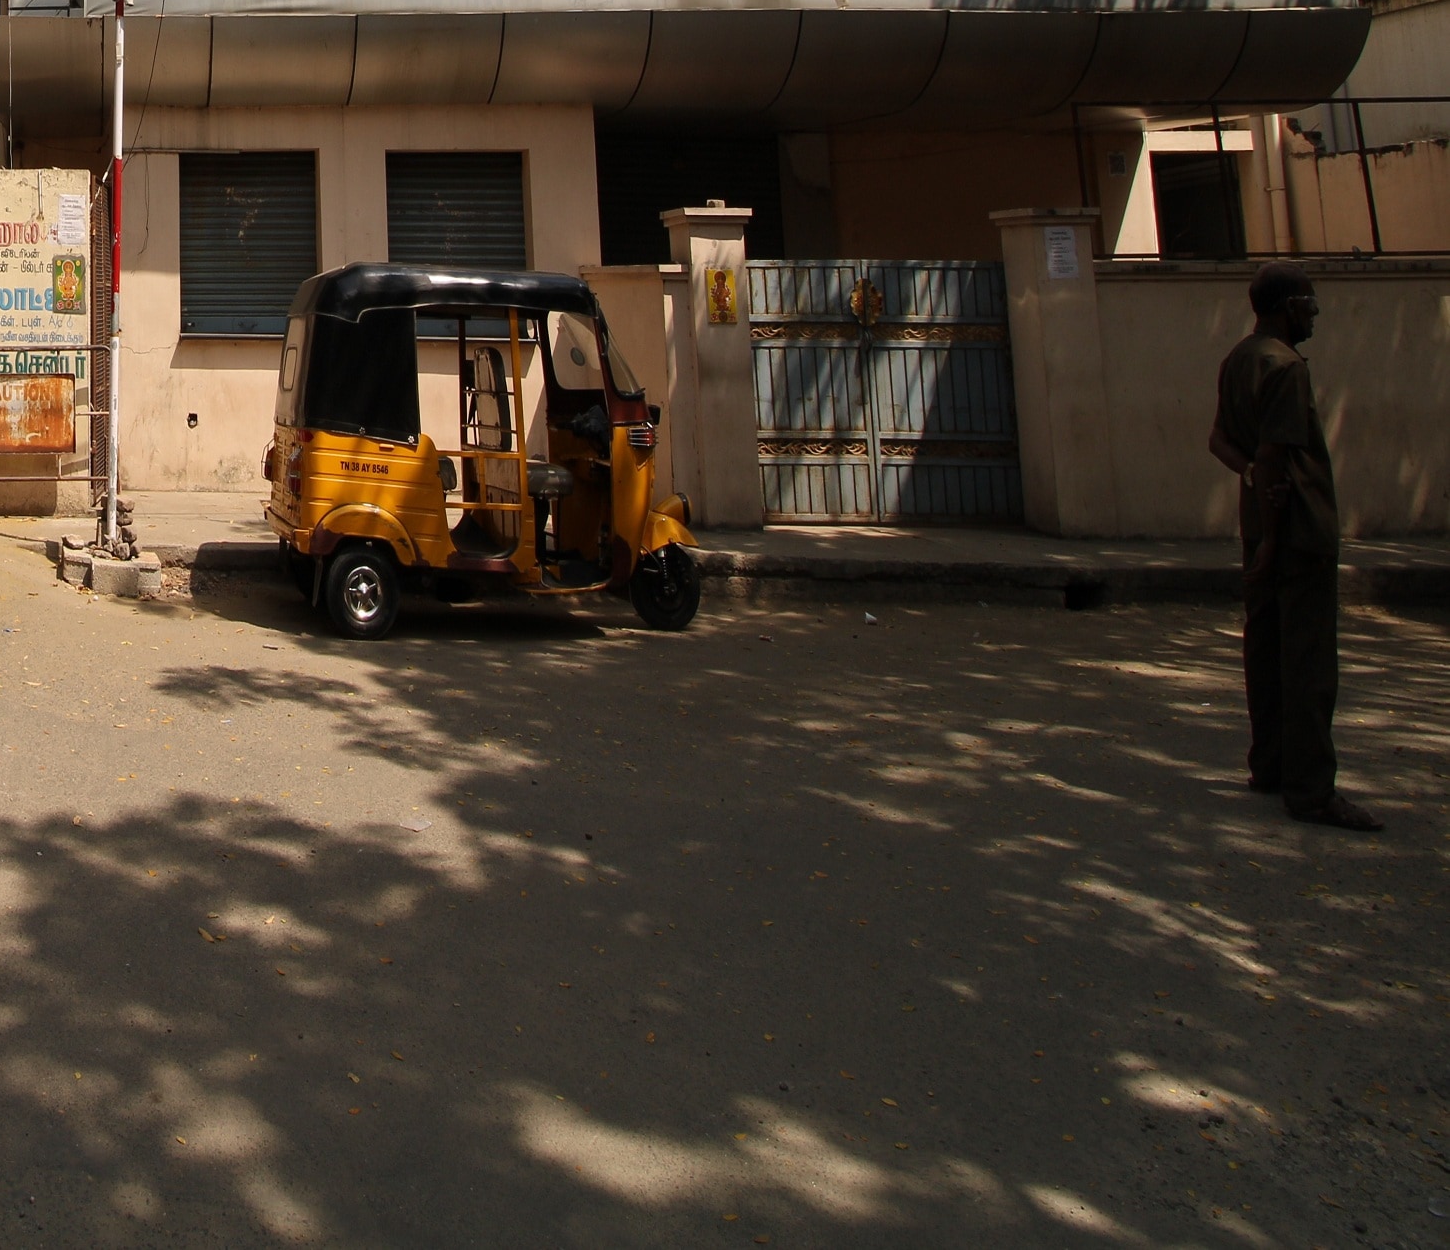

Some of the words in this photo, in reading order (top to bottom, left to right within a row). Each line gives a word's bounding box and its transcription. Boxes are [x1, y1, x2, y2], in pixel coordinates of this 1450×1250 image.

[340, 461, 350, 470] TN
[352, 462, 360, 472] 38
[361, 463, 370, 472] AY
[372, 464, 389, 474] 8546
